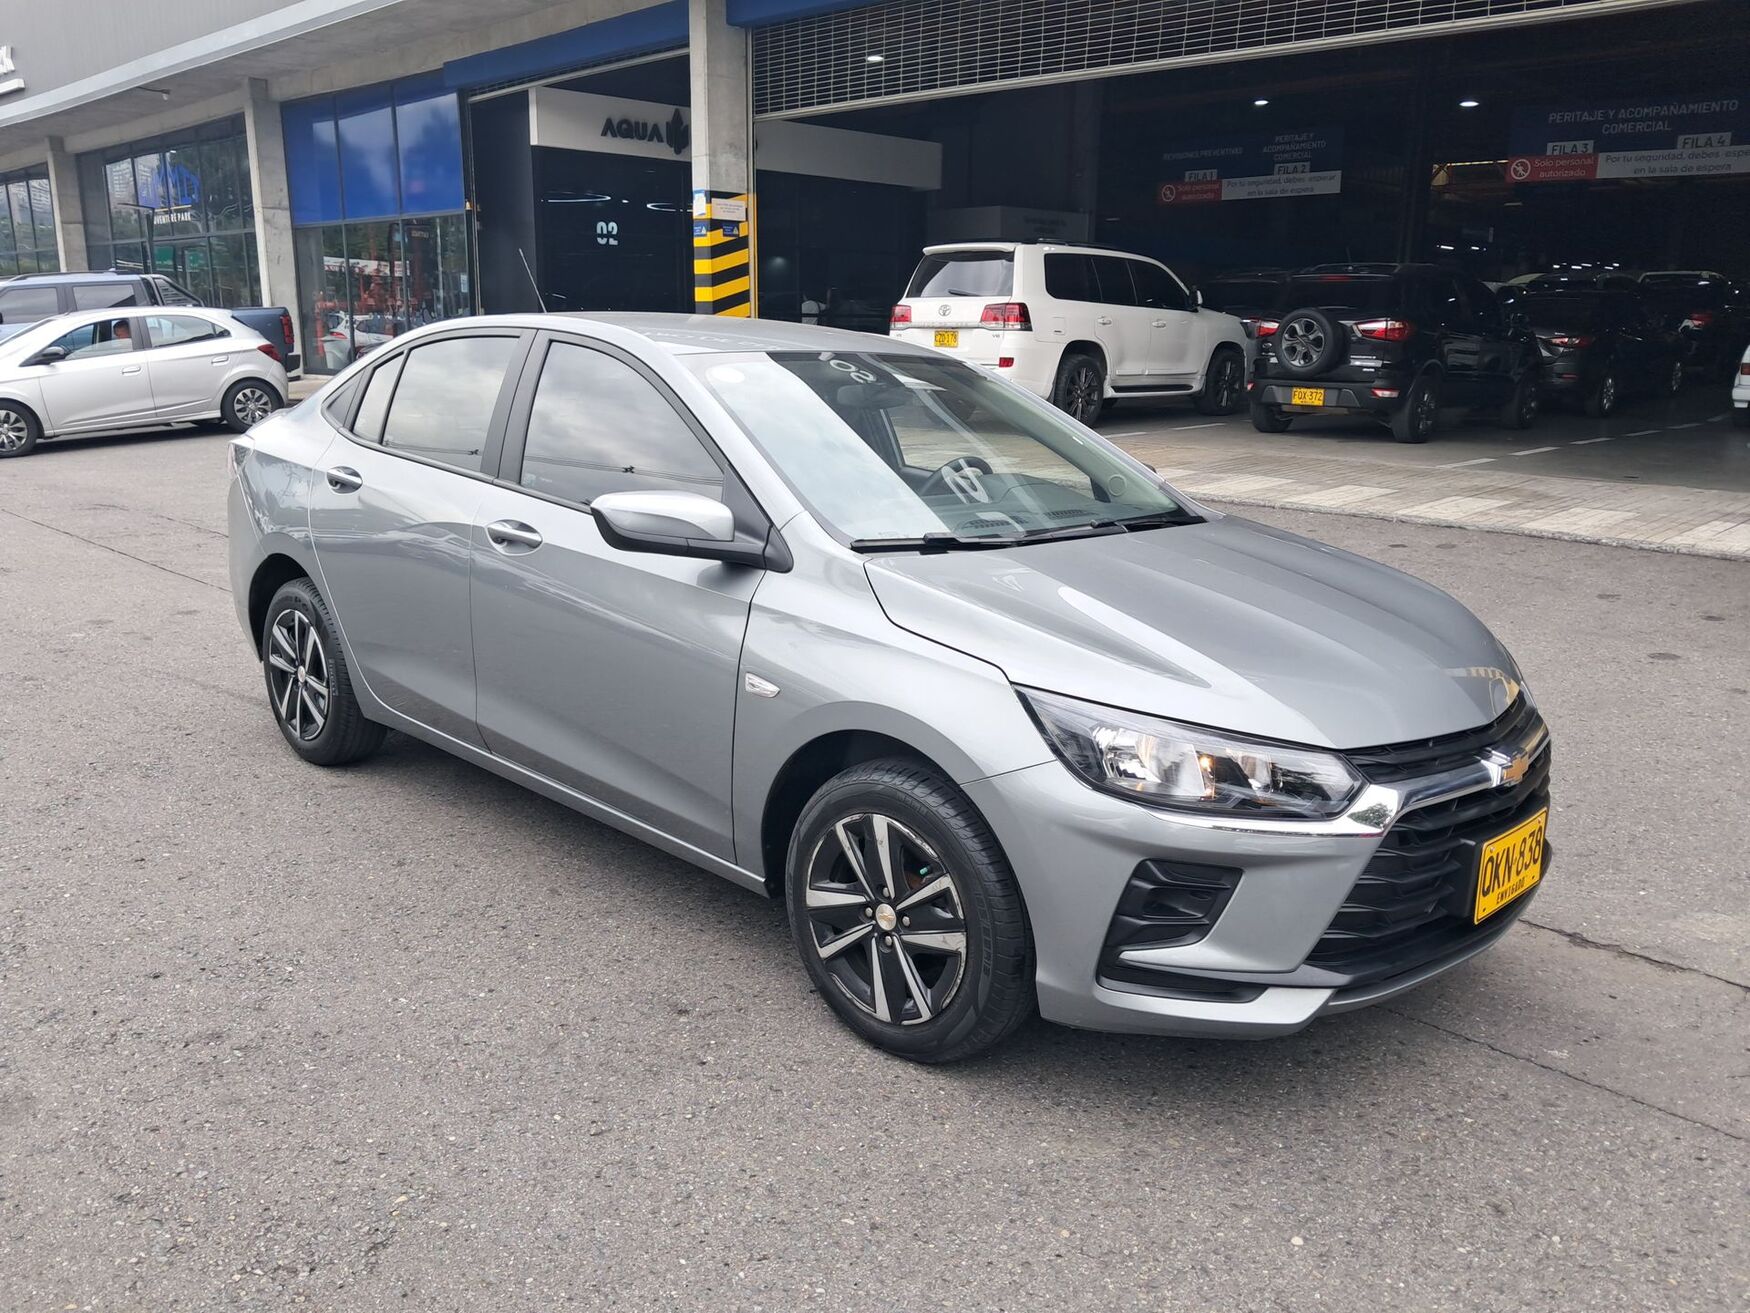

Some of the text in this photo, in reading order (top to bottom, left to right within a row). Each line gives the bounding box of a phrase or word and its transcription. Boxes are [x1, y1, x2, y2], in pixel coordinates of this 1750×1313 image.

[1549, 100, 1739, 124] PERITAJE Y ACOMPAÑAMIENTO
[601, 117, 664, 143] AQUA
[1601, 120, 1672, 134] COMERCIAL
[1682, 134, 1726, 149] FILA 4
[1552, 143, 1589, 155] FILA 3
[1534, 157, 1594, 168] Solo personal
[1605, 154, 1620, 164] Por
[1622, 154, 1632, 162] tu
[1278, 164, 1307, 175] FILA 2
[1539, 168, 1586, 179] autorizado
[1695, 163, 1732, 174] espera
[1188, 172, 1208, 182] FILA
[177, 211, 191, 222] PARK
[596, 221, 619, 246] 02
